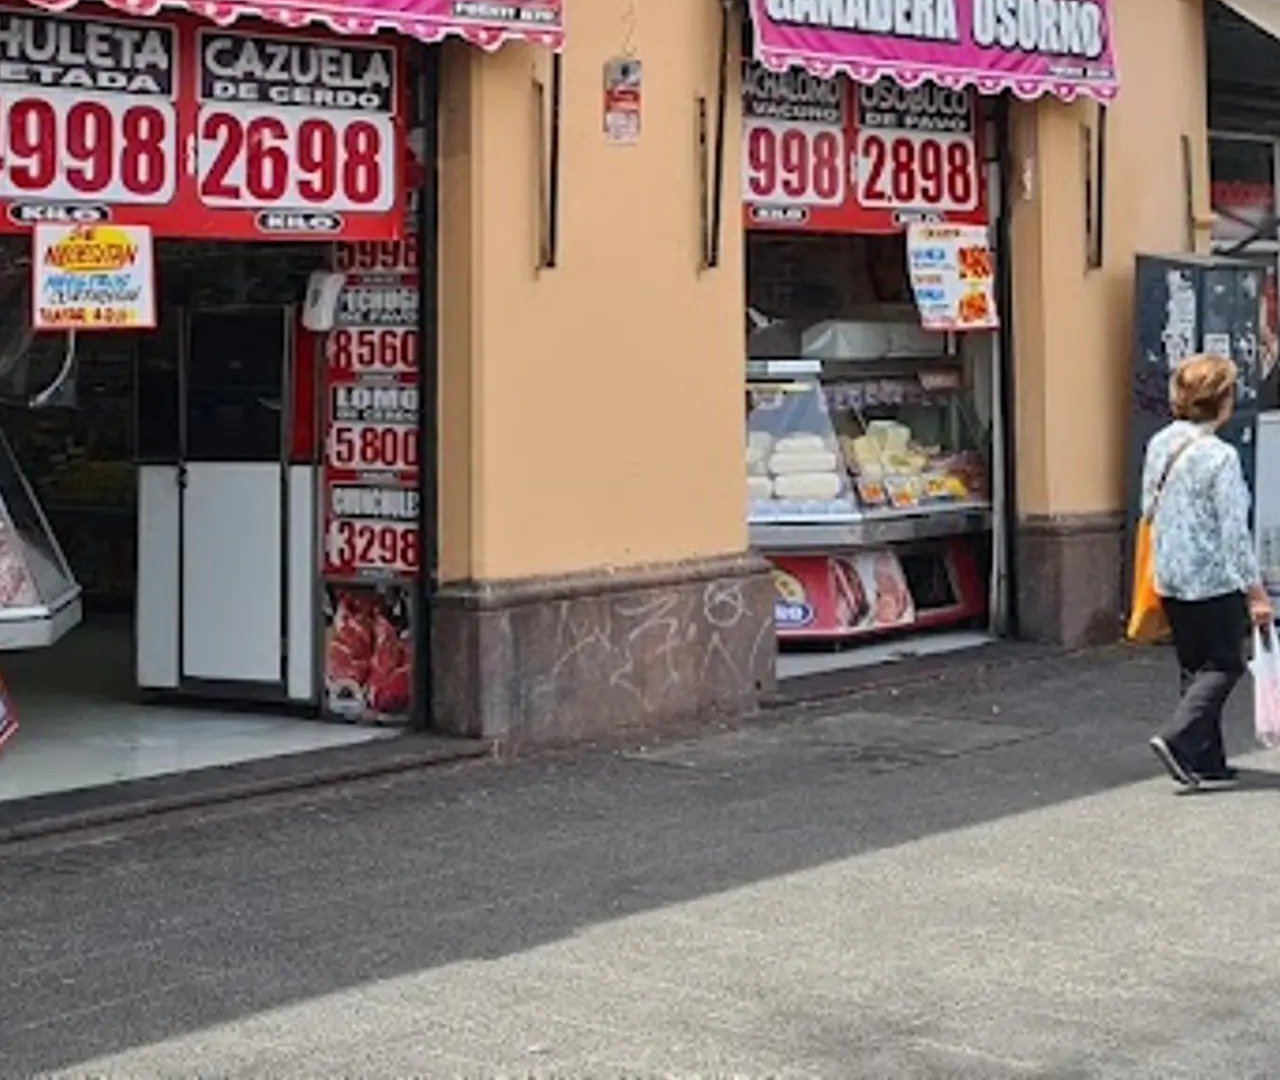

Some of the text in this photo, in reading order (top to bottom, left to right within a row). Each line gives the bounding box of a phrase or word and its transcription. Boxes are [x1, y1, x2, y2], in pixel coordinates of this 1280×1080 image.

[204, 37, 390, 88] CAZUELA
[213, 81, 259, 99] DE
[201, 112, 381, 204] 2698
[748, 127, 839, 199] 998
[21, 204, 101, 221] KILO
[266, 214, 334, 230] KILO
[336, 386, 418, 410] LOMO
[337, 521, 418, 567] 3298
